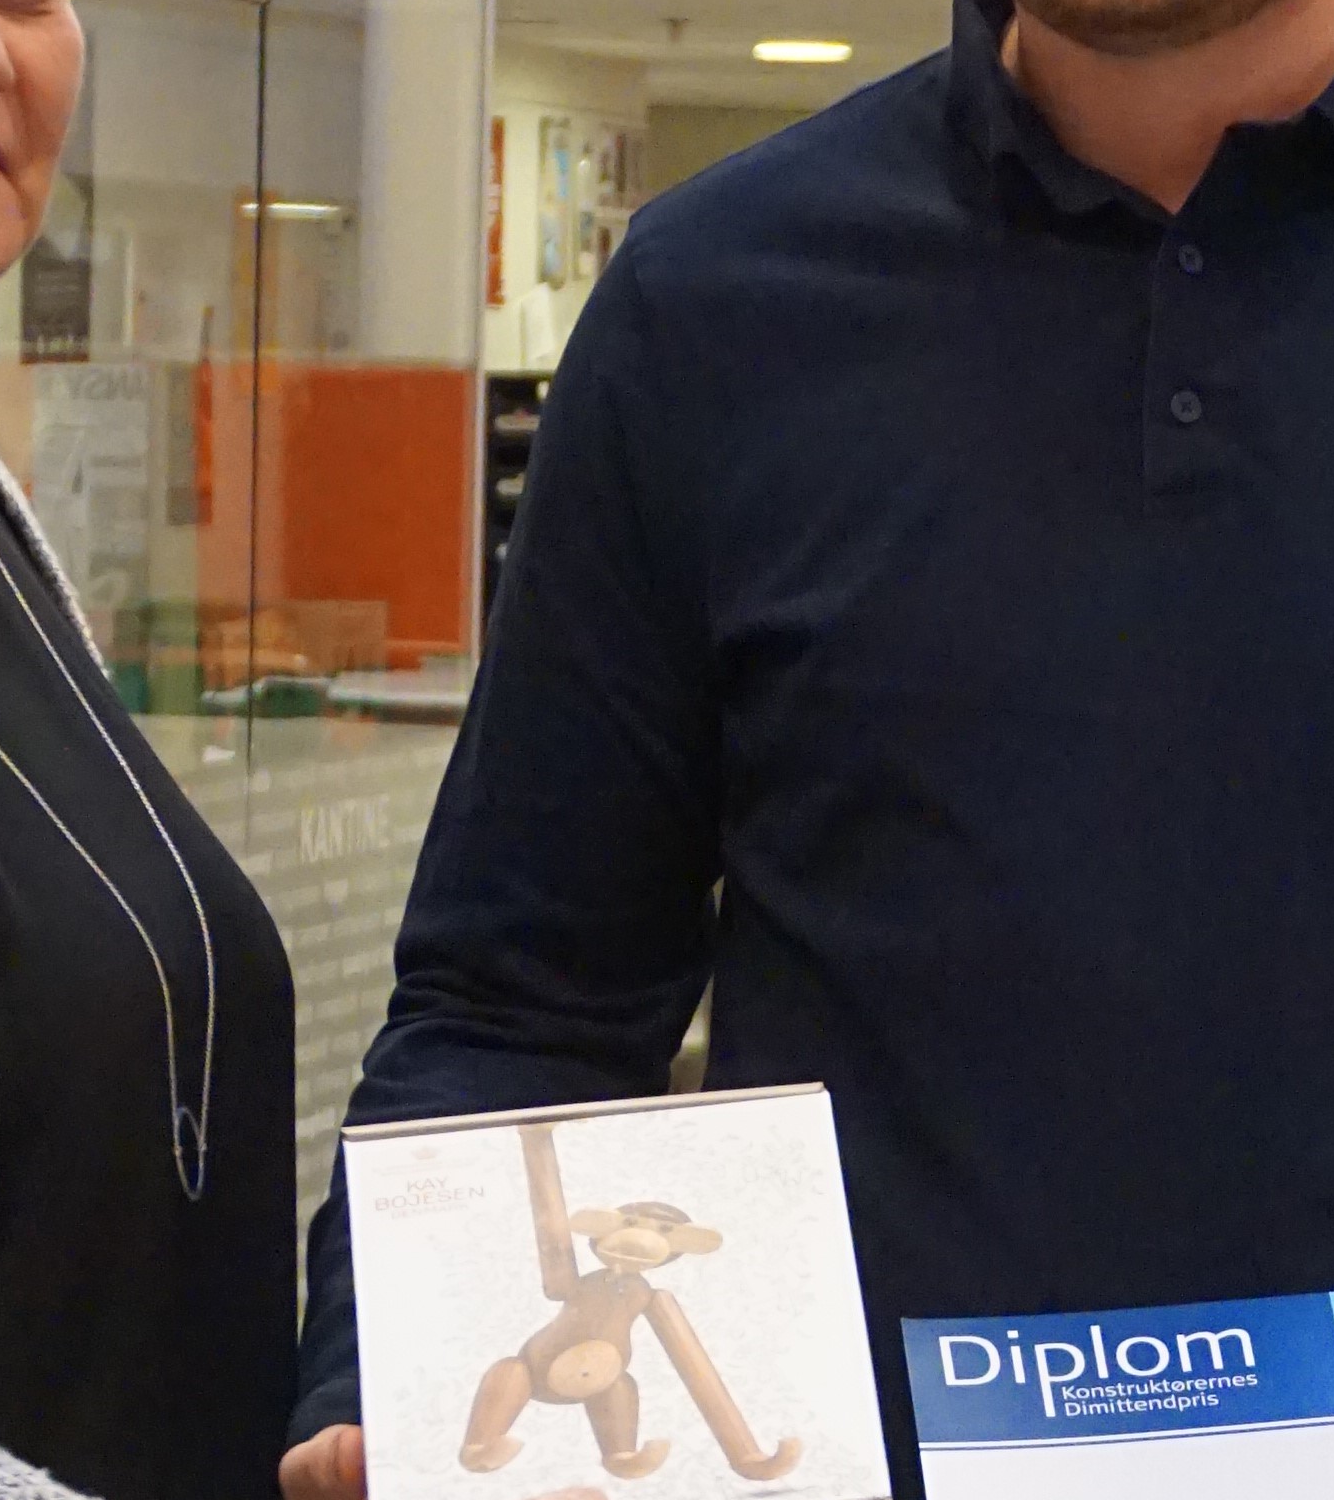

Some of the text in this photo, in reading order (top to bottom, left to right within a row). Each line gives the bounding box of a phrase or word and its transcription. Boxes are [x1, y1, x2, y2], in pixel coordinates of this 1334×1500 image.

[300, 793, 390, 864] KANTINE
[375, 1185, 486, 1212] BOJESEN
[406, 1176, 448, 1193] KAY
[938, 1325, 1255, 1418] Diplom
[1062, 1372, 1259, 1401] Konstruktørernes
[1064, 1392, 1220, 1417] Dimittendpris
